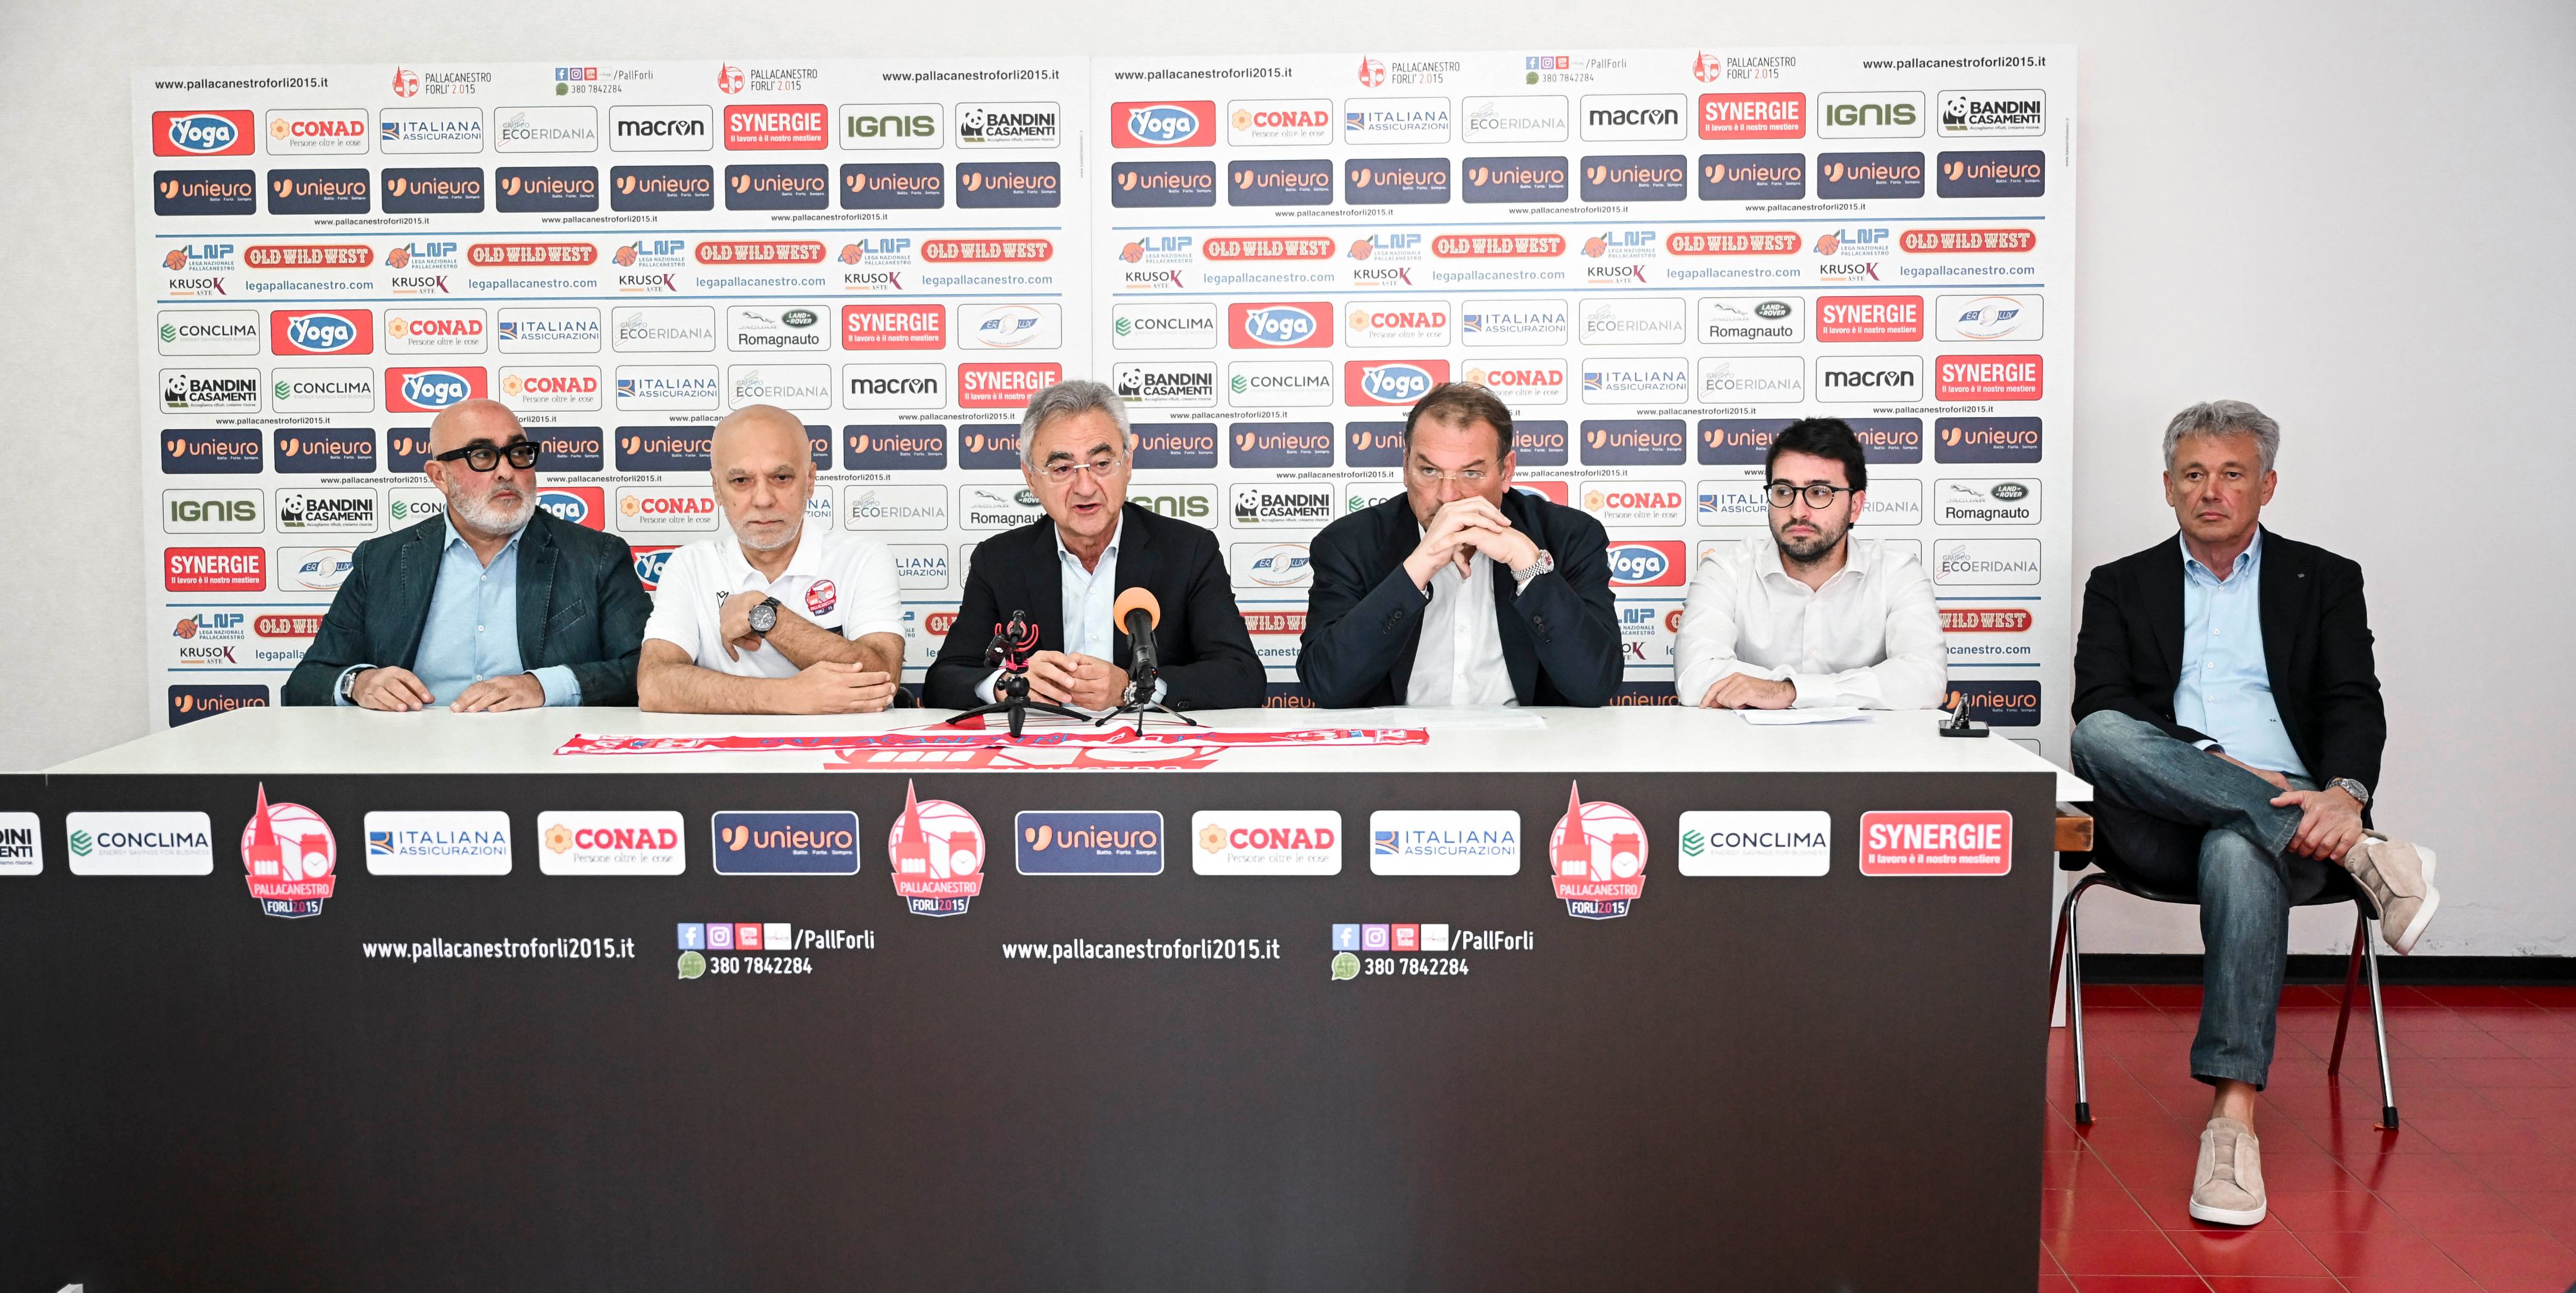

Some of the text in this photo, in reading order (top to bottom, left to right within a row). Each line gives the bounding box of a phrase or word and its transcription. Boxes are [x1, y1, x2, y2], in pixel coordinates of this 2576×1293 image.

[1393, 62, 1459, 72] PALLACANESTRO
[1586, 59, 1626, 69] /PallForli
[1728, 57, 1795, 67] PALLACANESTRO
[1863, 57, 2045, 71] www.pallacanestroforli2015.it
[426, 72, 491, 83] PALLACANESTRO
[614, 71, 653, 80] /PallForli
[751, 69, 817, 79] PALLACANESTRO
[883, 70, 1059, 83] www.pallacanestroforli2015.it
[1115, 68, 1292, 81] www.pallacanestroforli2015.it
[156, 78, 328, 91] www.pallacanestroforli2015.it
[572, 85, 585, 93] 380
[1706, 101, 1798, 121] SYNERGIE
[1827, 104, 1916, 126] IGNIS
[1970, 101, 2040, 114] BANDINI
[731, 113, 821, 132] SYNERGIE
[987, 113, 1055, 127] BANDINI
[1254, 111, 1328, 127] CONAD
[1369, 112, 1447, 122] ITALIANA
[1471, 115, 1565, 130] ECOERIDANIA
[1590, 110, 1677, 125] macron
[1969, 115, 2040, 124] CASAMENTI
[292, 121, 364, 137] CONAD
[404, 122, 480, 132] ITALIANA
[618, 120, 704, 136] macron
[848, 116, 934, 137] IGNIS
[986, 125, 1055, 137] CASAMENTI
[1136, 111, 1190, 139] Yoga
[177, 119, 230, 148] Yoga
[503, 127, 595, 141] ECOERIDANIA
[1375, 168, 1446, 185] unieuro
[1492, 166, 1563, 184] unieuro
[1611, 165, 1683, 182] unieuro
[1848, 163, 1920, 180] unieuro
[1968, 161, 2040, 178] unieuro
[411, 178, 480, 194] unieuro
[525, 176, 594, 193] unieuro
[640, 176, 709, 192] unieuro
[870, 173, 940, 190] unieuro
[986, 173, 1055, 189] unieuro
[1141, 172, 1211, 188] unieuro
[183, 180, 251, 197] unieuro
[1275, 209, 1393, 218] www.pallacanestroforli2015.it
[1745, 204, 1865, 212] www.pallacanestroforli2015.it
[314, 218, 428, 226] www.pallacanestroforli2015.it
[771, 214, 887, 222] www.pallacanestroforli2015.it
[1841, 229, 1889, 244] LNP
[1906, 233, 2030, 249] OLD WILD WEST
[189, 244, 234, 258] LNP
[250, 249, 368, 264] OLD WILD WEST
[1900, 266, 2034, 278] legapallacanestro.com
[246, 280, 373, 292] legapallacanestro.com
[1371, 313, 1446, 328] CONAD
[1486, 314, 1565, 324] ITALIANA
[1824, 304, 1916, 323] SYNERGIE
[410, 320, 483, 335] CONAD
[849, 313, 939, 331] SYNERGIE
[1135, 319, 1213, 330] CONCLIMA
[1253, 311, 1306, 342] Yoga
[180, 326, 256, 336] CONCLIMA
[295, 318, 347, 348] Yoga
[1710, 326, 1792, 340] Romagnauto
[739, 334, 819, 347] Romagnauto
[1145, 374, 1212, 386] BANDINI
[1826, 371, 1914, 386] macron
[1943, 364, 2035, 382] SYNERGIE
[190, 379, 256, 391] BANDINI
[852, 379, 937, 394] macron
[1143, 385, 1212, 396] CASAMENTI
[190, 393, 256, 401] CASAMENTI
[190, 439, 258, 455] unieuro
[1259, 432, 1330, 449] unieuro
[307, 499, 372, 511] BANDINI
[641, 498, 715, 514] CONAD
[1606, 493, 1681, 509] CONAD
[171, 501, 256, 521] IGNIS
[306, 512, 372, 520] CASAMENTI
[1946, 507, 2029, 521] Romagnauto
[171, 556, 259, 573] SYNERGIE
[1982, 612, 2027, 629] WEST
[98, 833, 208, 848] CONCLIMA
[400, 832, 505, 844] ITALIANA
[575, 829, 677, 849] CONAD
[754, 825, 852, 848] unieuro
[1057, 825, 1157, 849] unieuro
[1230, 828, 1334, 849] CONAD
[1406, 831, 1514, 843] ITALIANA
[1711, 833, 1826, 847] CONCLIMA
[1869, 824, 2001, 849] SYNERGIE
[400, 847, 506, 855] ASSICURAZIONI
[573, 853, 610, 862] Persone
[614, 853, 636, 862] oltre
[641, 853, 648, 862] le
[1405, 846, 1514, 854] ASSICURAZIONI
[1869, 854, 2001, 864] Il lavoro è il nostro mestiere
[254, 884, 329, 895] PALLACANESTRO
[900, 881, 976, 894] PALLACANESTRO
[1560, 883, 1638, 895] PALLACANESTRO
[794, 929, 875, 950] /PallForli
[1451, 930, 1534, 951] /PallForli
[363, 938, 635, 963] www.pallacanestroforli2015.it
[1003, 939, 1280, 964] www.pallacanestroforli2015.it
[710, 957, 812, 974] 380 7842284
[1365, 957, 1469, 976] 380 7842284
